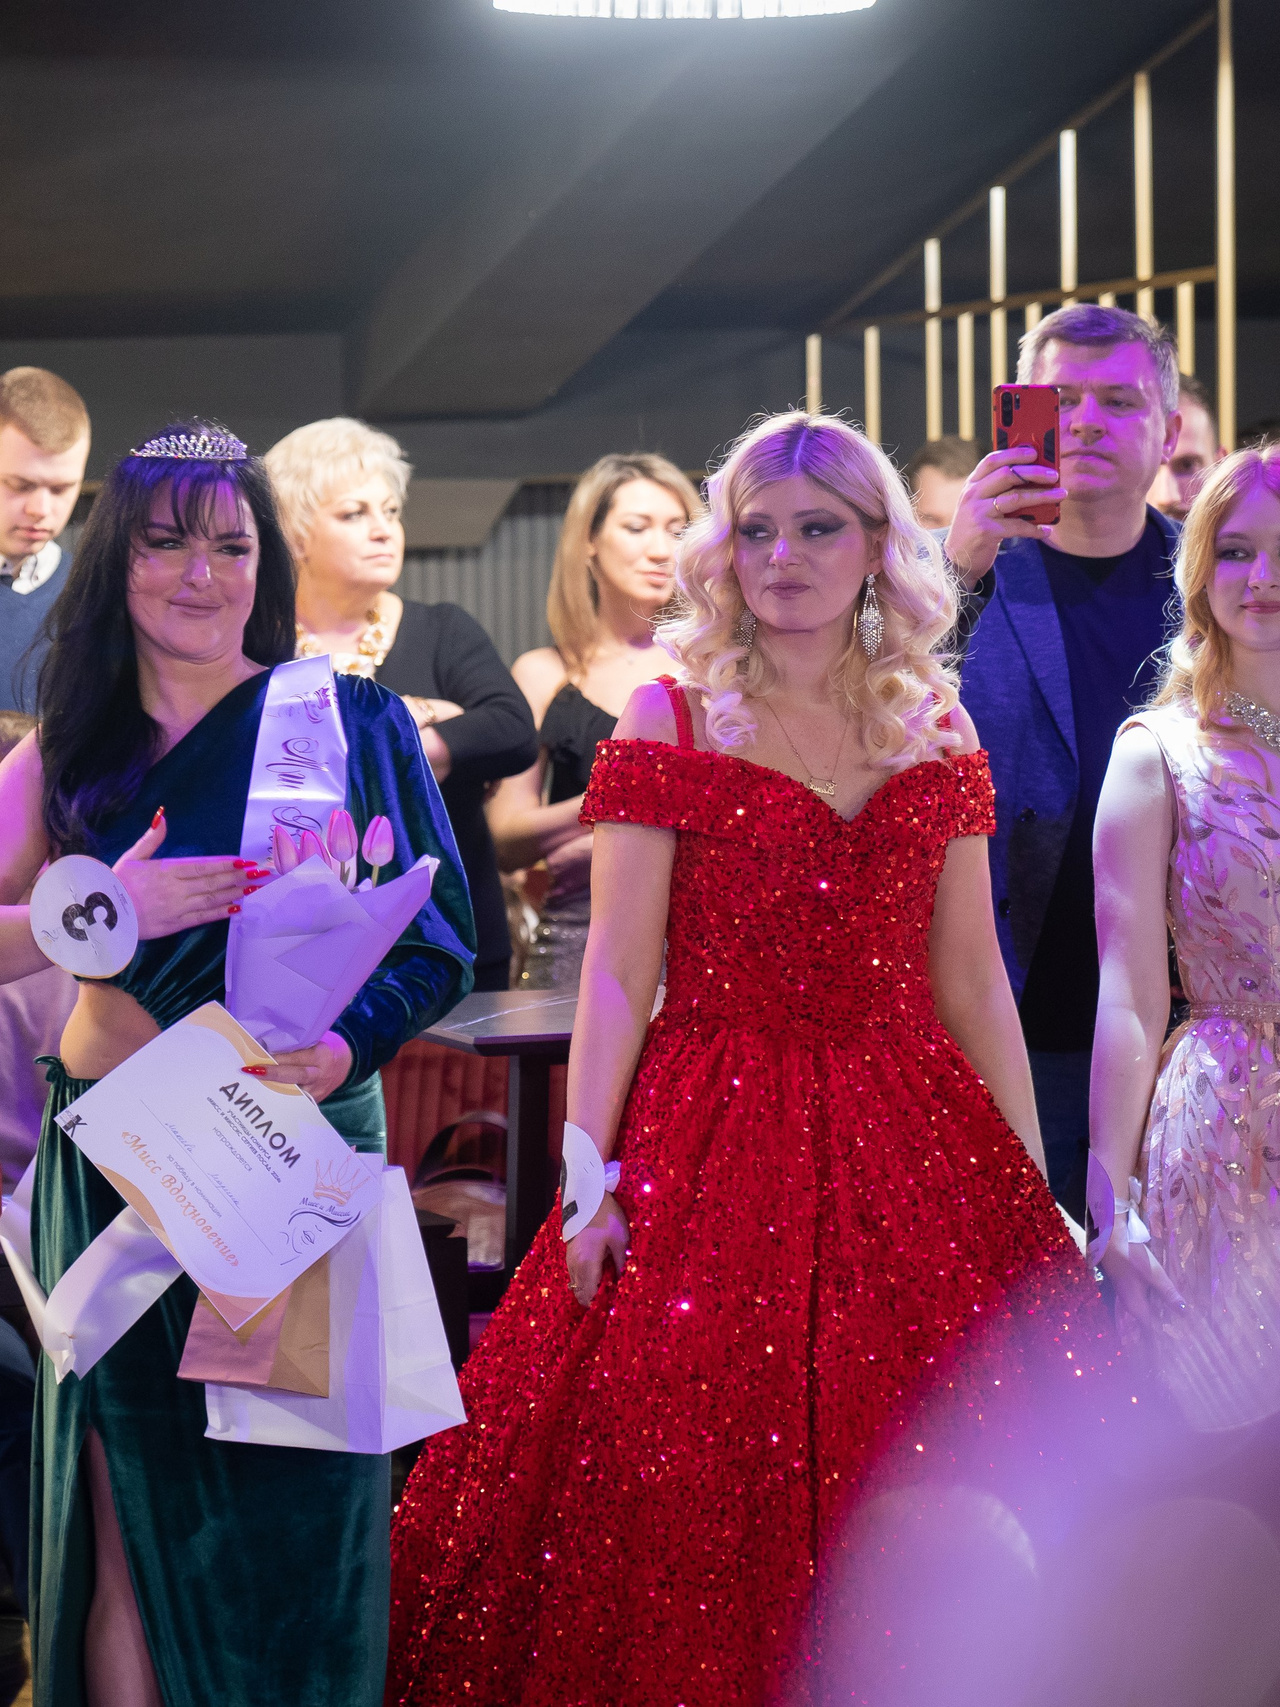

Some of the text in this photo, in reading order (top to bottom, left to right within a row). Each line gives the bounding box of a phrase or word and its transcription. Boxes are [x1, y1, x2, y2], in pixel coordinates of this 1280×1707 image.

[62, 892, 118, 941] 3
[212, 1127, 253, 1172] награждается
[219, 1082, 301, 1169] ДИПЛОМ
[223, 1116, 243, 1137] МИССИС
[241, 1135, 258, 1155] СЕРГИЕВ
[256, 1153, 272, 1172] ПОСАД
[227, 1109, 271, 1160] УЧАСТНИЦЫ КОНКУРСА
[121, 1131, 239, 1267] «Мисс Вдохновение»
[167, 1154, 175, 1163] за
[173, 1161, 192, 1184] победу
[194, 1185, 222, 1219] номинации
